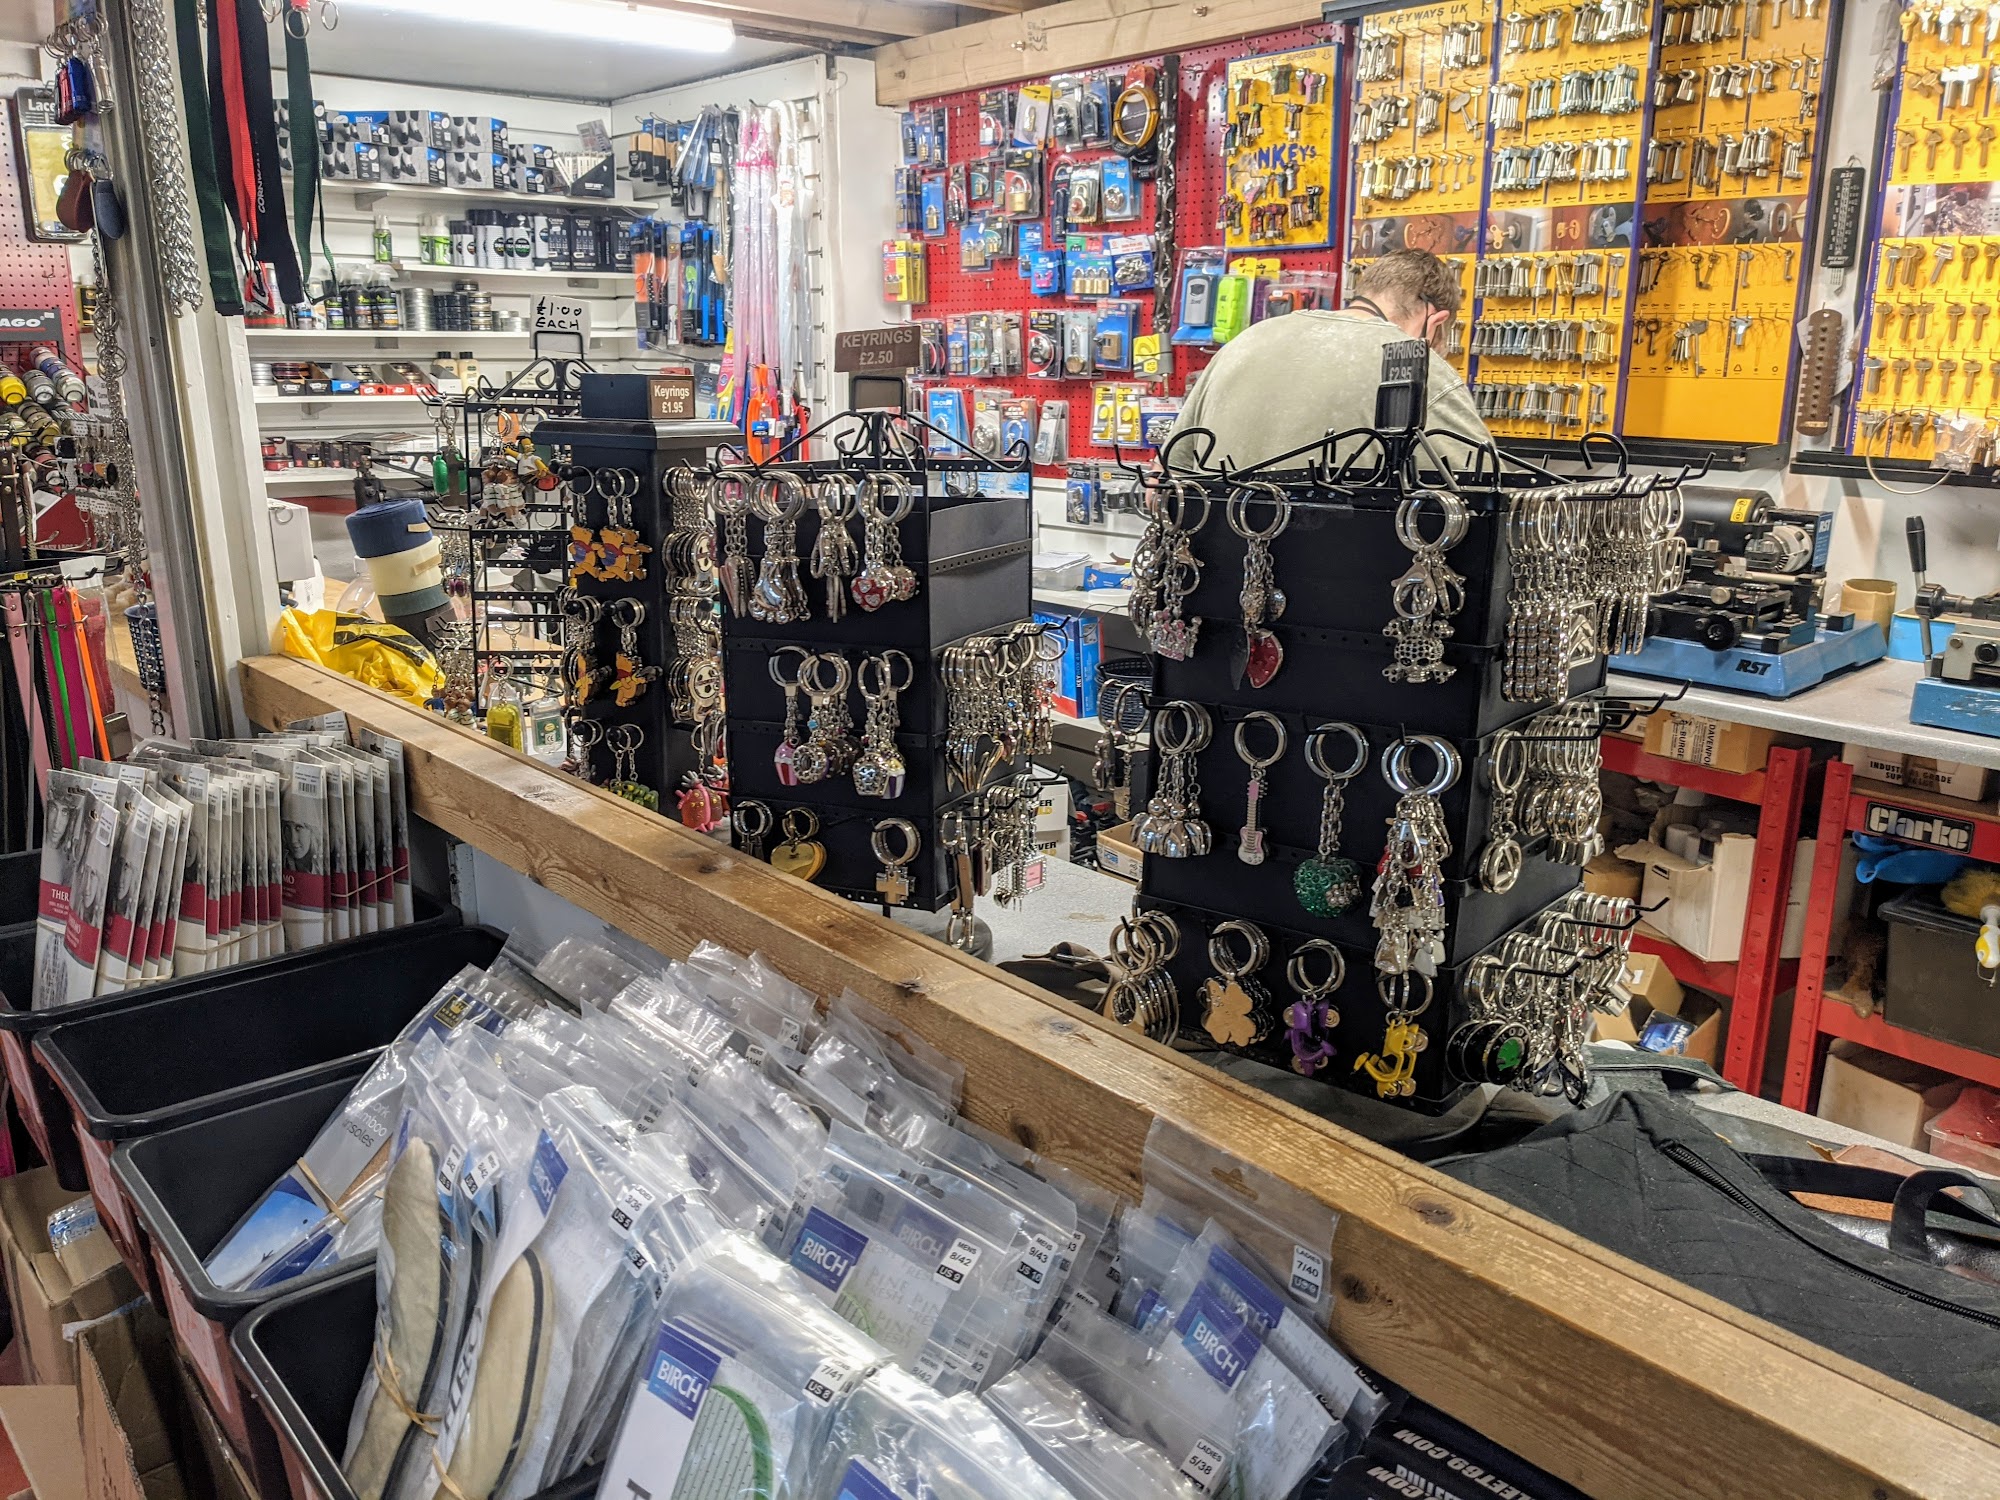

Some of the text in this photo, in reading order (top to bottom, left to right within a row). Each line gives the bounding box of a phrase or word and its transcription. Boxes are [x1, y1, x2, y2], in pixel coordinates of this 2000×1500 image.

[1388, 3, 1469, 25] KEYWAYS UK
[537, 296, 582, 316] £1.00
[536, 317, 579, 330] EACH
[842, 329, 913, 348] KEYRINGS
[859, 350, 894, 365] £2.50
[1389, 367, 1412, 381] £295
[654, 385, 690, 399] Keyrings
[662, 402, 684, 414] £1.95
[1818, 519, 1831, 532] RST
[1735, 659, 1772, 676] RST
[1870, 806, 1969, 850] Clarke
[52, 888, 70, 901] THER
[1672, 1024, 1688, 1045] JMA
[625, 1194, 642, 1211] 3/36
[614, 1210, 632, 1228] US 5
[900, 1224, 943, 1259] BIRCH
[957, 1241, 978, 1255] MENS
[1035, 1237, 1054, 1251] MENS
[800, 1237, 848, 1278] BIRCH
[950, 1252, 972, 1267] 8/42
[1029, 1246, 1049, 1264] 9/43
[938, 1265, 961, 1282] US 9
[1296, 1261, 1319, 1277] 7/40
[1192, 1321, 1239, 1378] BIRCH
[657, 1359, 702, 1403] BIRCH
[821, 1365, 844, 1381] 7/41
[808, 1381, 831, 1399] US 8
[1196, 1442, 1222, 1462] LADIES
[1188, 1455, 1213, 1475] 5/38
